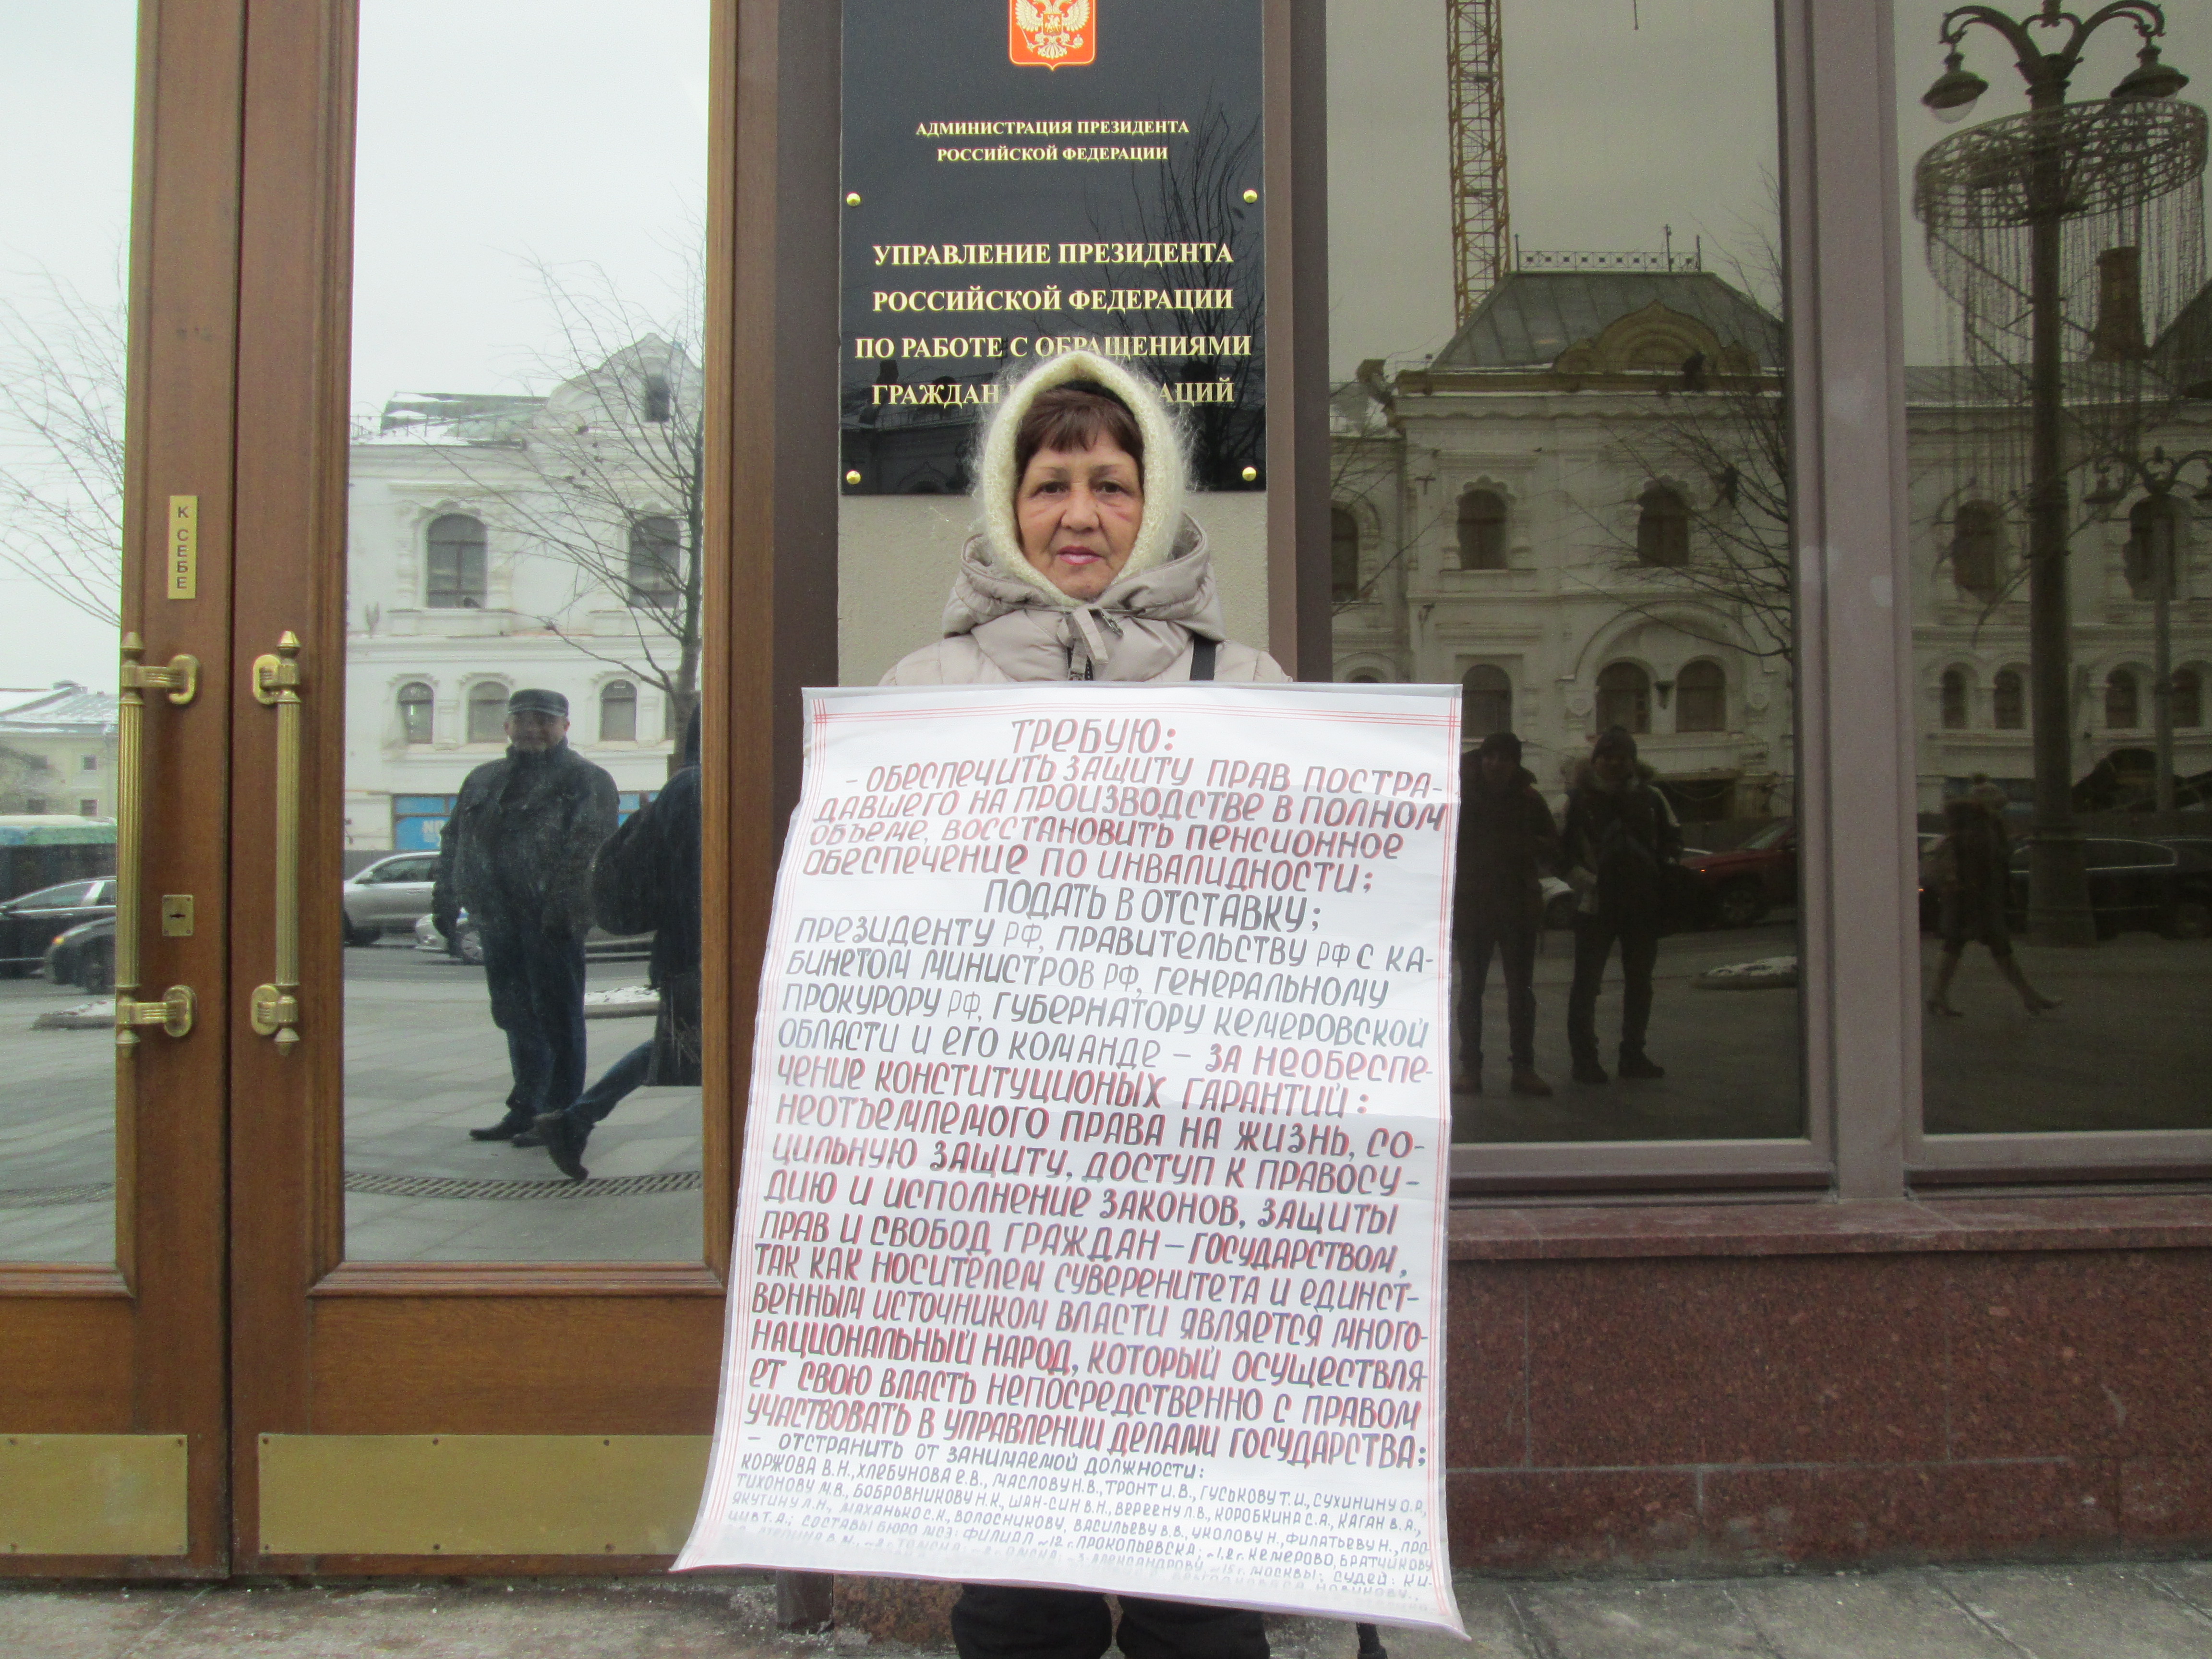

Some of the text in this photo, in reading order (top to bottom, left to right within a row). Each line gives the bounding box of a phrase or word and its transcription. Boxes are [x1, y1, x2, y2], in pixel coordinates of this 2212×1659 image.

[915, 120, 1190, 137] АДМИНИСТРАЦИЯ ПРЕЗИДЕНТА
[937, 145, 1168, 161] РОССИЙСКОЙ ФЕДЕРАЦИИ
[873, 242, 1234, 267] УПРАВЛЕНИЕ ПРЕЗИДЕНТА
[873, 285, 1234, 313] РОССИЙСКОЙ ФЕДЕРАЦИИ
[855, 338, 895, 359] ПО
[901, 337, 1003, 358] РАБОТЕ
[1009, 337, 1028, 357] С
[871, 384, 1000, 409] ГРАЖДАН
[178, 506, 190, 518] К
[177, 529, 189, 589] СЕБЕ
[1012, 719, 1176, 754] ТРЕБУЮ:
[866, 754, 1442, 798] ОБЕСПЕЧИТЬ ЗАЩИТУ ПРАВ ПОСТРА-
[813, 783, 1448, 829] ДАВШЕГО НА ПРОИЗВОДСТВЕ В ПОЛНОМ
[810, 816, 1404, 859] ОБЪЕМЕ, ВОССТАНОВИТЬ ПЕНСИОННОЕ
[803, 844, 1372, 893] ОБЕСПЕЧЕНИЕ ПО ИНВАЛИДНОСТИ;
[984, 879, 1321, 933] ПОДАТЬ В ОТСТАВКУ;
[795, 915, 1433, 973] ПРЕЗИДЕНТУ РФ, ПРАВИТЕЛЬСТВУ РФ С КА-
[786, 948, 1389, 1009] БИНЕТОМ МИНИСТРОВ РФ, ГЕНЕРАЛЬНОМУ
[782, 983, 1429, 1048] ПРОКУРОРУ РФ, ГУБЕРНАТОРУ КЕМЕРОВСКОЙ
[778, 1019, 1432, 1083] ОБЛАСТИ И ЕГО КОМАНДЕ ЗА НЕОБЕСПЕ-
[778, 1055, 1369, 1118] ЧЕНИЕ КОНСТИТУЦИОНЫХ ГАРАНТИЙ:
[776, 1094, 1425, 1162] НЕОТЪЕМЛЕМОГО ПРАВА НА ЖИЗНЬ, СО-
[772, 1133, 917, 1169] ЦИЛЬНУЮ
[1082, 1151, 1215, 1187] ДОСТУП
[1225, 1157, 1246, 1188] К
[1255, 1159, 1419, 1197] ПРАВОСУ-
[763, 1169, 1399, 1235] ДИЮ И ИСПОЛНЕНИЕ ЗАКОНОВ, ЗАЩИТЫ
[759, 1210, 1407, 1278] ПРАВ И СВОБОД ГРАЖДАН ГОСУДАРСТВОМ,
[755, 1243, 800, 1279] ТАК
[810, 1246, 863, 1281] КАК
[870, 1251, 1045, 1292] НОСИТЕЛЕМ
[1054, 1262, 1260, 1305] СУВЕРЕНИТЕТА
[1270, 1277, 1291, 1307] И
[752, 1282, 1428, 1352] ВЕННЫМ ИСТОЧНИКОМ ВЛАСТИ ЯВЛЯЕТСЯ МНОГО-
[751, 1319, 1428, 1392] НАЦИОНАЛЬНЫЙ НАРОД, КОТОРЫЙ ОСУЩЕСТВЛЯ-
[749, 1358, 1422, 1431] ЕТ СВОЮ ВЛАСТЬ НЕПОСРЕДСТВЕННО С ПРАВОМ
[744, 1393, 1426, 1469] УЧАСТВОВАТЬ В УПРАВЛЕНИИ ДЕЛАМИ ГОСУДАРСТВА;
[779, 1433, 903, 1459] ОТСТРАНИТЬ
[915, 1443, 939, 1461] ОТ
[947, 1446, 1078, 1472] ЗАНИМАЕМОЙ
[737, 1474, 815, 1494] ТИХОНОВУ
[853, 1482, 973, 1505] БОБРОВНИКОВУ
[1009, 1495, 1081, 1513] ШАН-СИН
[1214, 1506, 1301, 1525] КОРОБКИНА
[1338, 1512, 1385, 1530] КАГАН
[741, 1453, 816, 1475] КОРЖОВА
[992, 1473, 1070, 1493] МАСЛОВУ
[1105, 1480, 1158, 1497] ТРОНТ
[1200, 1485, 1276, 1506] ГУСЬКОВУ
[1313, 1492, 1396, 1512] СУХИНИНУ
[732, 1491, 799, 1508] ЯКУТИНУ
[1073, 1518, 1157, 1537] ВАСИЛЬЕВУ
[1286, 1532, 1375, 1551] ФИЛАТЬЕВУ
[802, 1515, 873, 1532] СОСТАВЫ
[963, 1527, 1034, 1545] ФИЛИАЛ
